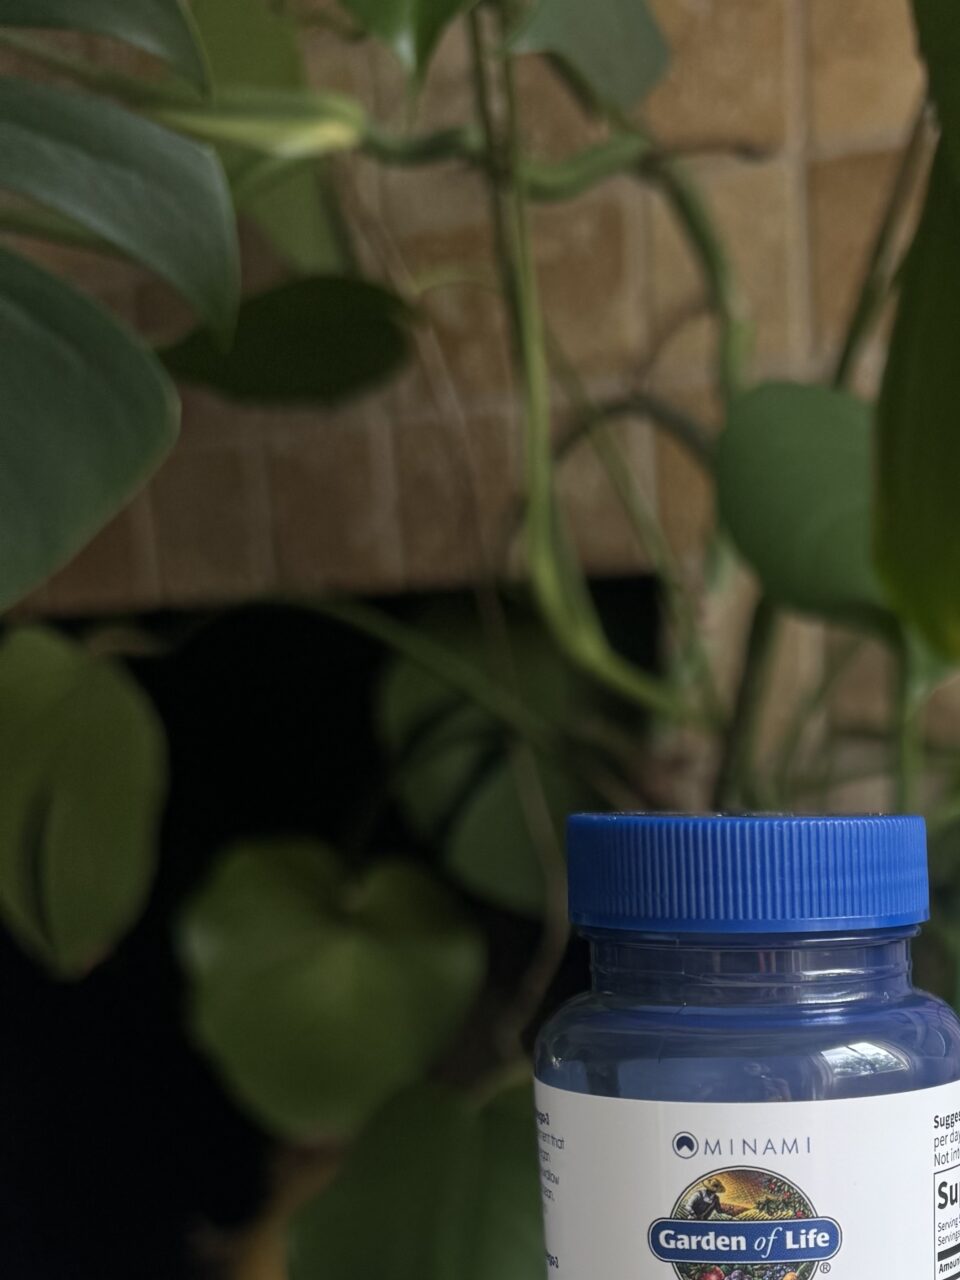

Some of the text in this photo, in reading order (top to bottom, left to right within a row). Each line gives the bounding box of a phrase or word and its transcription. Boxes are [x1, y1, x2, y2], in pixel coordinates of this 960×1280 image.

[704, 1136, 812, 1157] MINAMI
[934, 1134, 948, 1152] per
[949, 1128, 960, 1144] day
[934, 1152, 949, 1167] Not
[659, 1226, 830, 1258] Garden of Life
